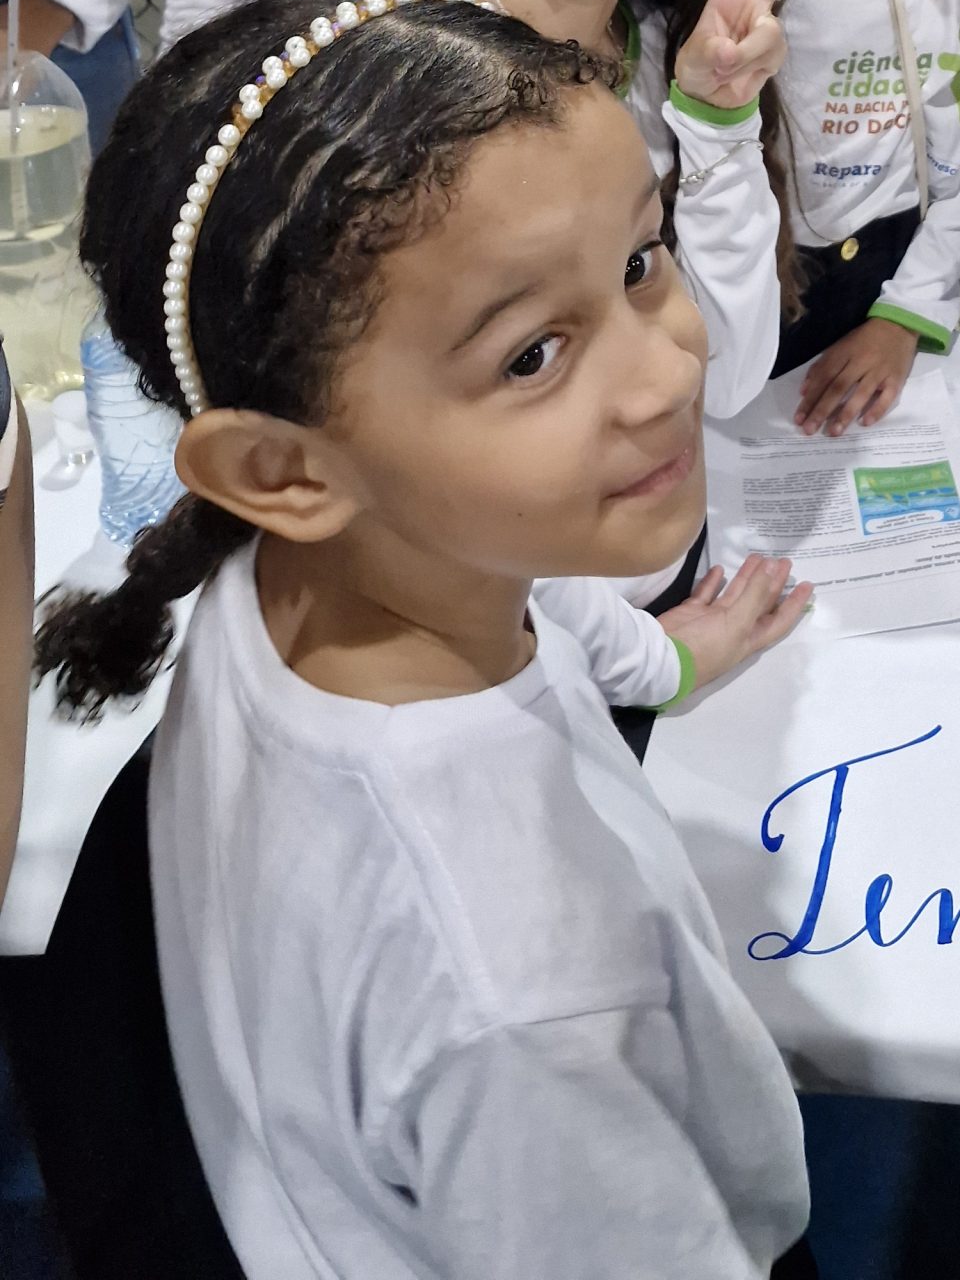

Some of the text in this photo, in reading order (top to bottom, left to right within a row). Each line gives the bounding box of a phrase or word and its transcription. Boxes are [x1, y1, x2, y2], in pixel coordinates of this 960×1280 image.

[833, 49, 933, 75] ciênca
[824, 101, 848, 114] NA
[853, 100, 896, 114] BACIA
[822, 119, 859, 135] RIO
[813, 161, 882, 180] Repara
